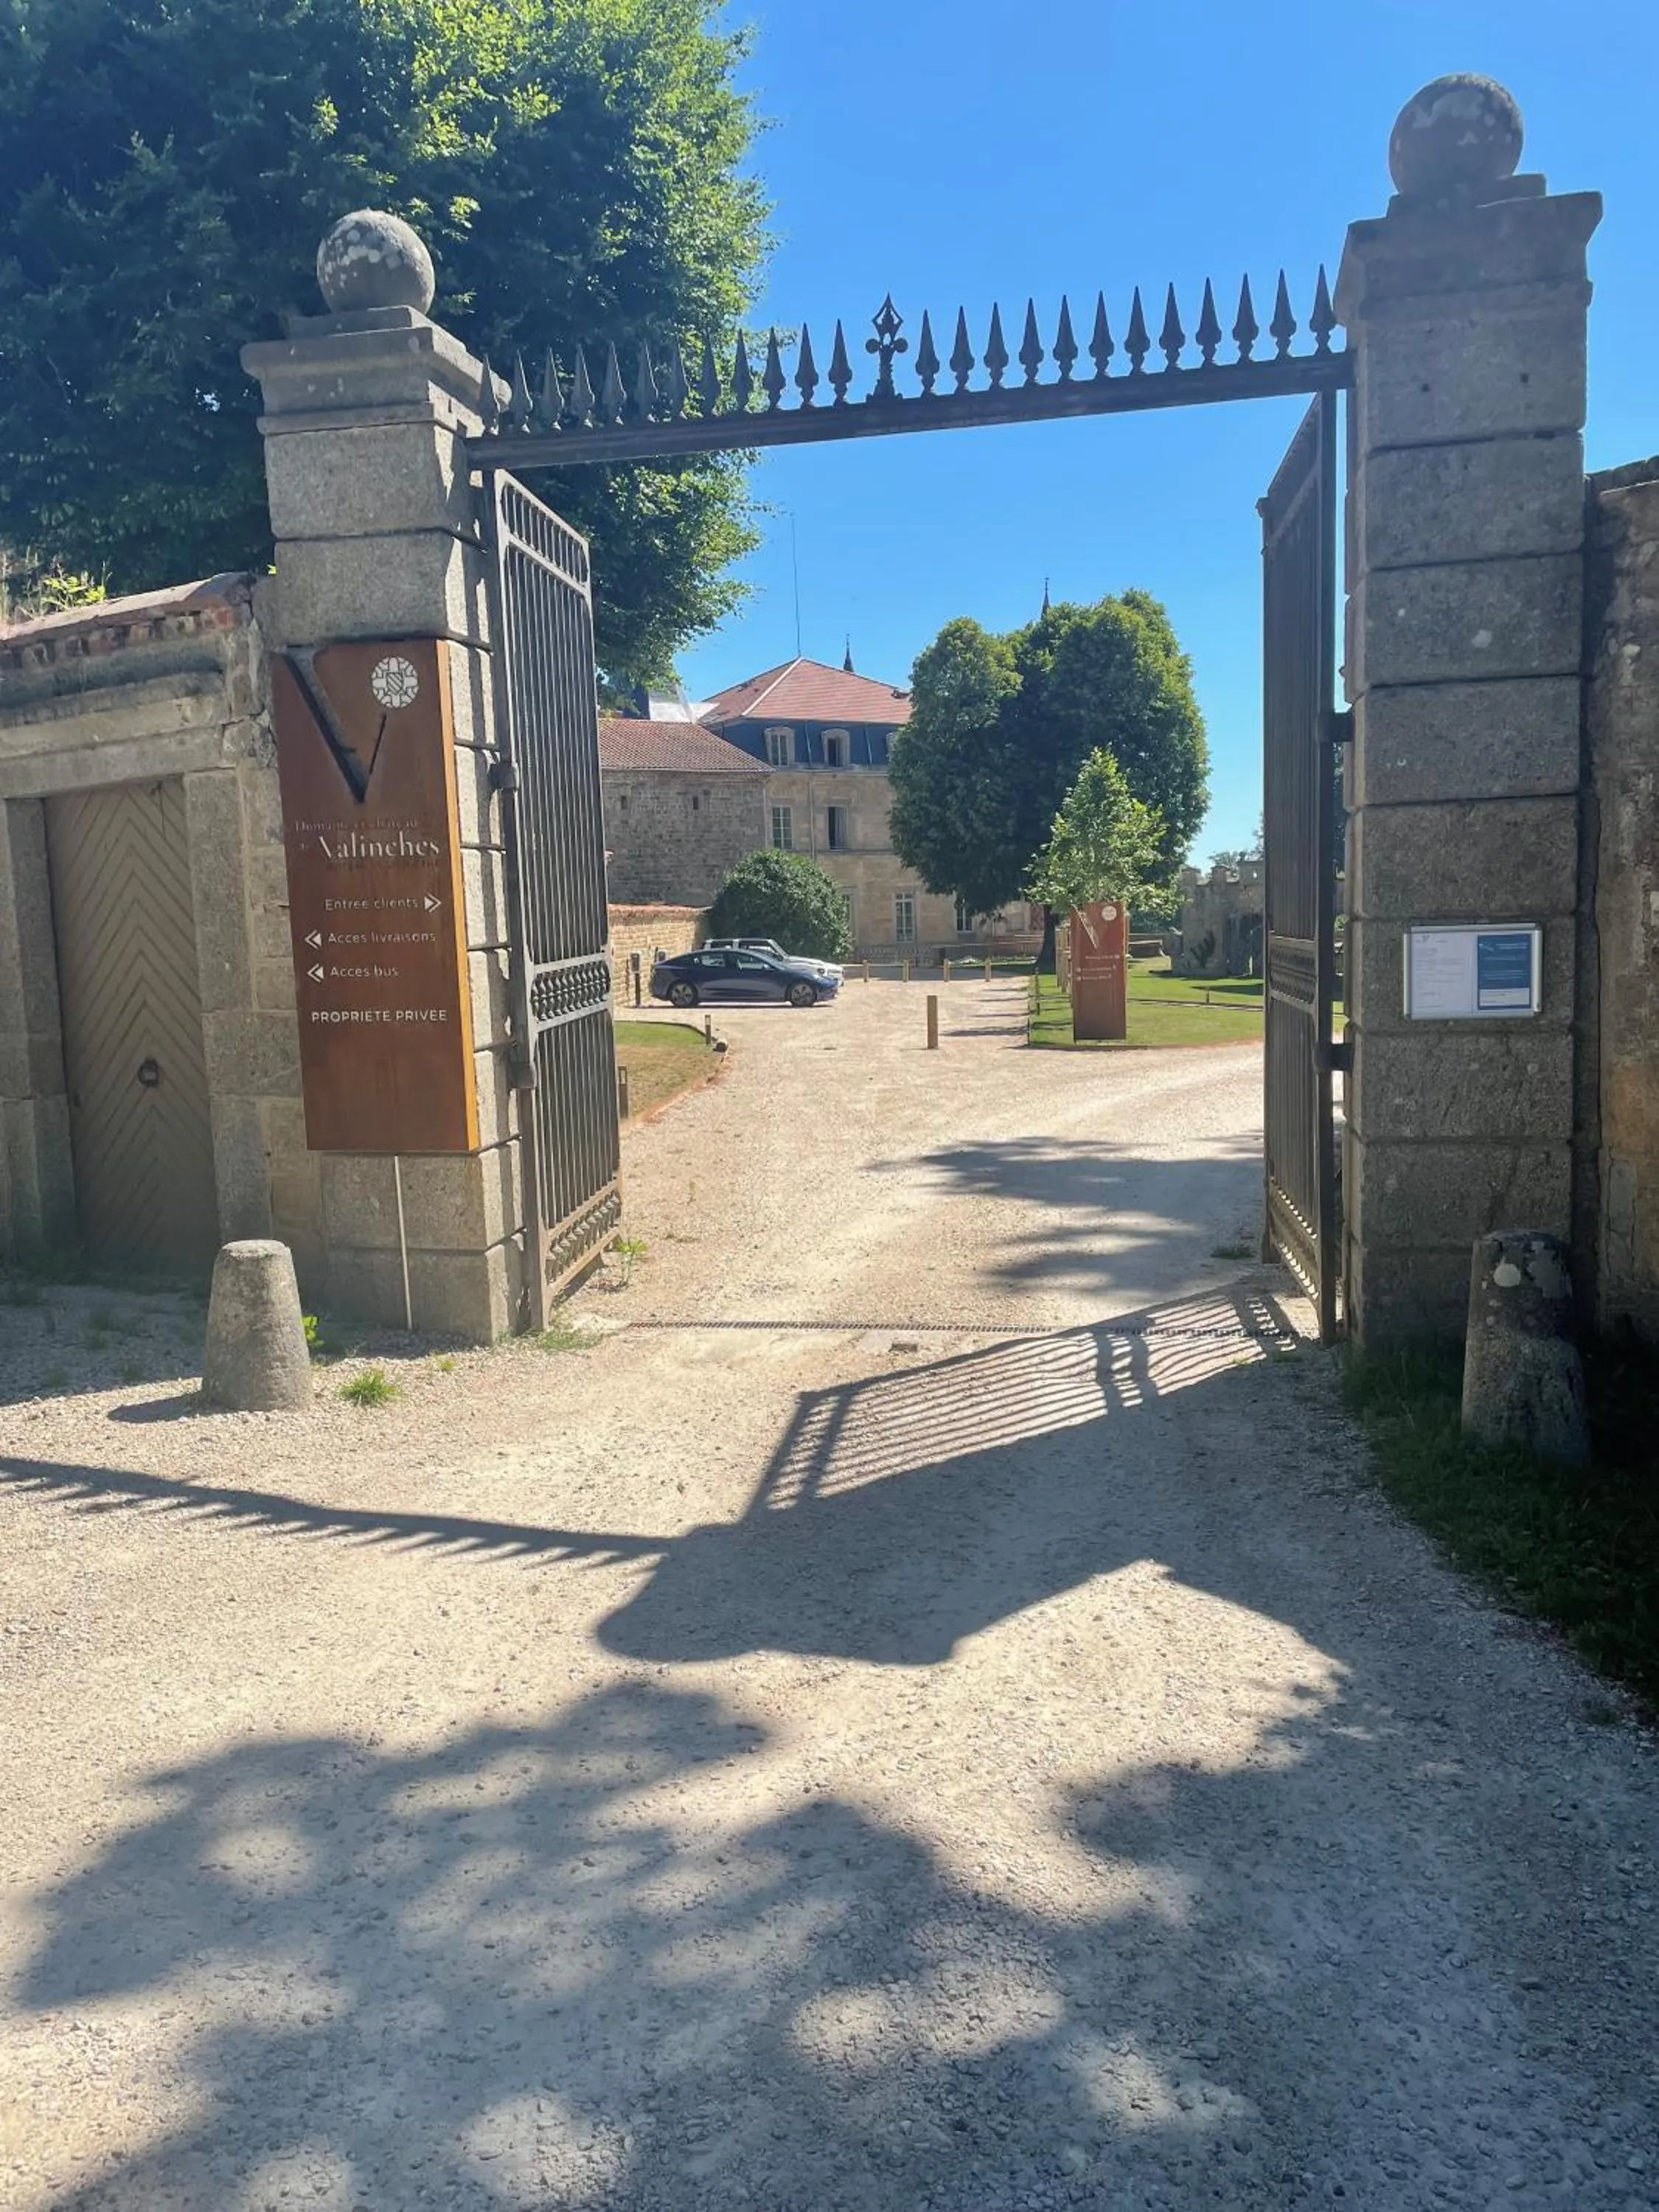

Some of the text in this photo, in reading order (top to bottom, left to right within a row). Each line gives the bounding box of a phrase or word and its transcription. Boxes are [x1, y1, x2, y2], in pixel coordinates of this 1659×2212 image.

[319, 830, 440, 859] Valinches
[374, 896, 419, 910] clients
[371, 931, 437, 944] livraisons
[374, 964, 400, 977] bus
